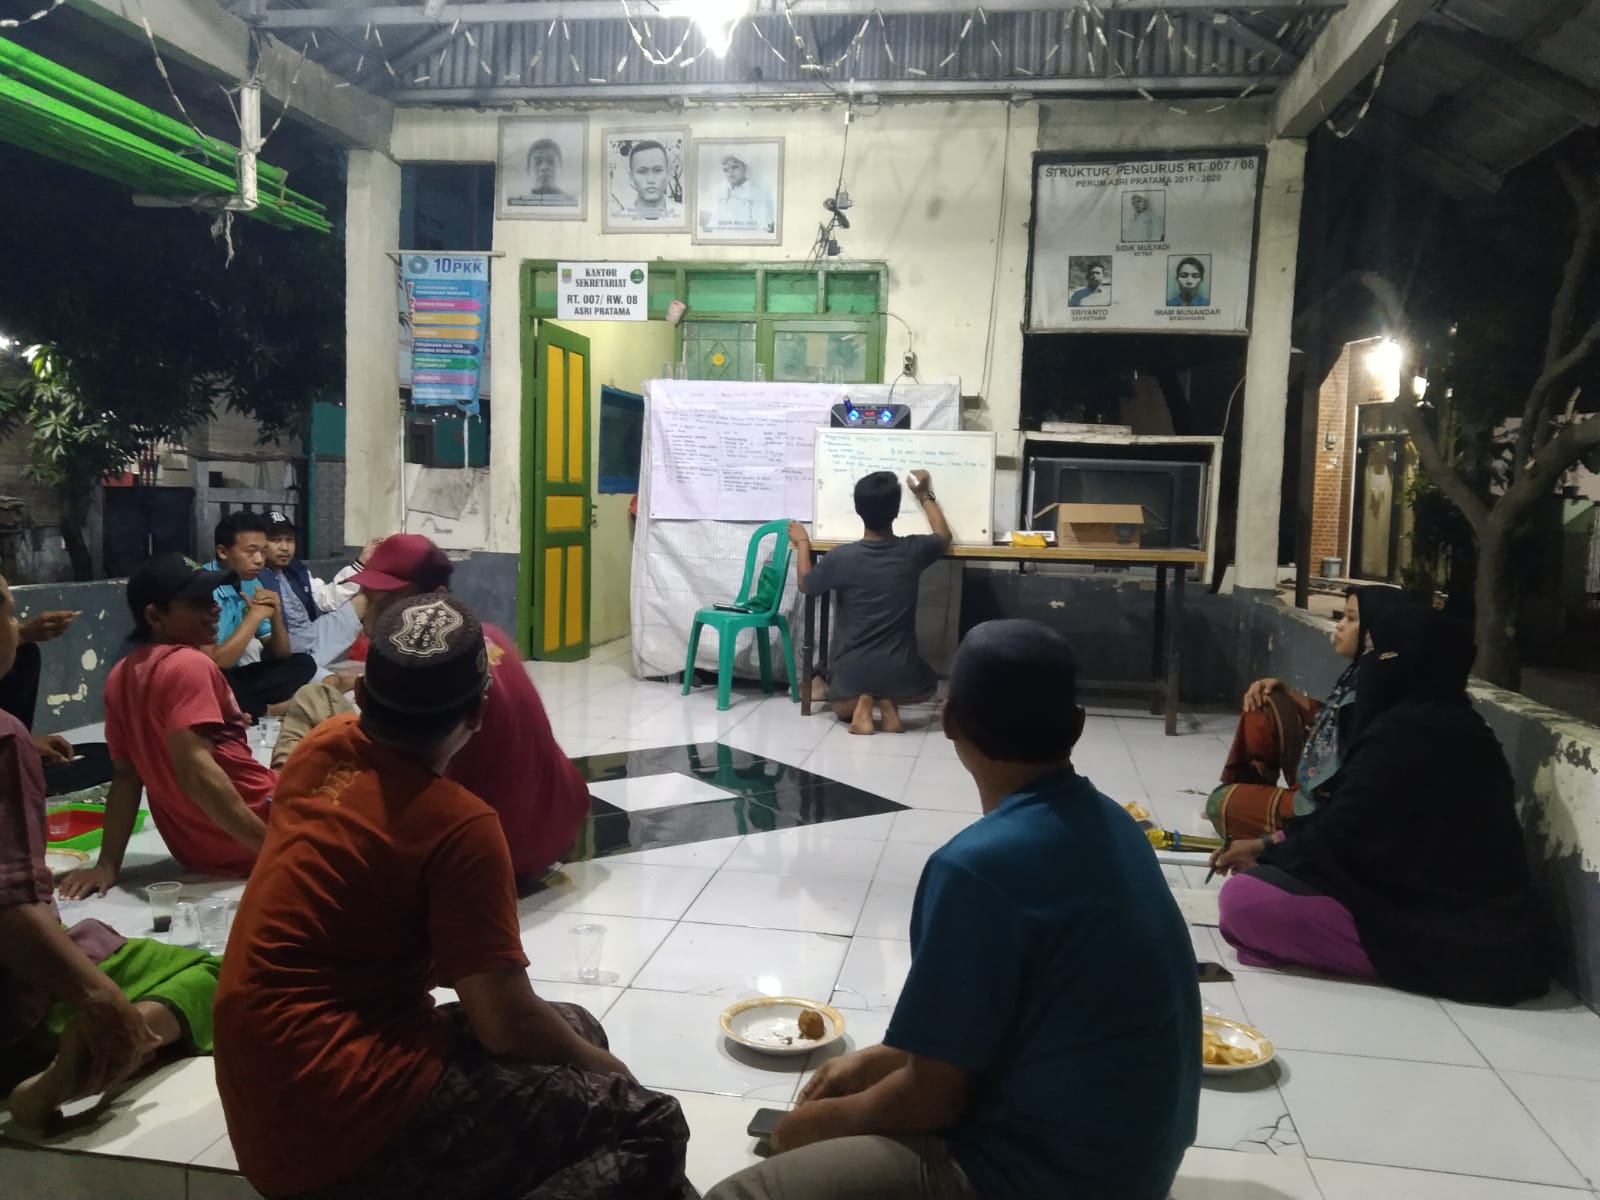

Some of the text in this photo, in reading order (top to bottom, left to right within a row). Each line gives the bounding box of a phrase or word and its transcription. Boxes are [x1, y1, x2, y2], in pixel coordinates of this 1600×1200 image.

[1045, 167, 1110, 178] STRUKTUR
[1116, 163, 1184, 175] PENGURUS
[1188, 162, 1206, 172] RT.
[1209, 161, 1230, 171] 007
[1241, 160, 1255, 170] 08
[1076, 179, 1107, 187] PERUM
[1108, 178, 1128, 186] ASRI
[1130, 177, 1172, 186] PRATAMA
[434, 258, 483, 274] 10 PKK
[585, 268, 617, 277] KANTOR
[575, 278, 627, 288] SEKRETARIAT
[567, 294, 580, 304] RT.
[606, 295, 624, 304] RW.
[626, 294, 638, 304] 08
[574, 307, 631, 316] ASRI PRATAMA
